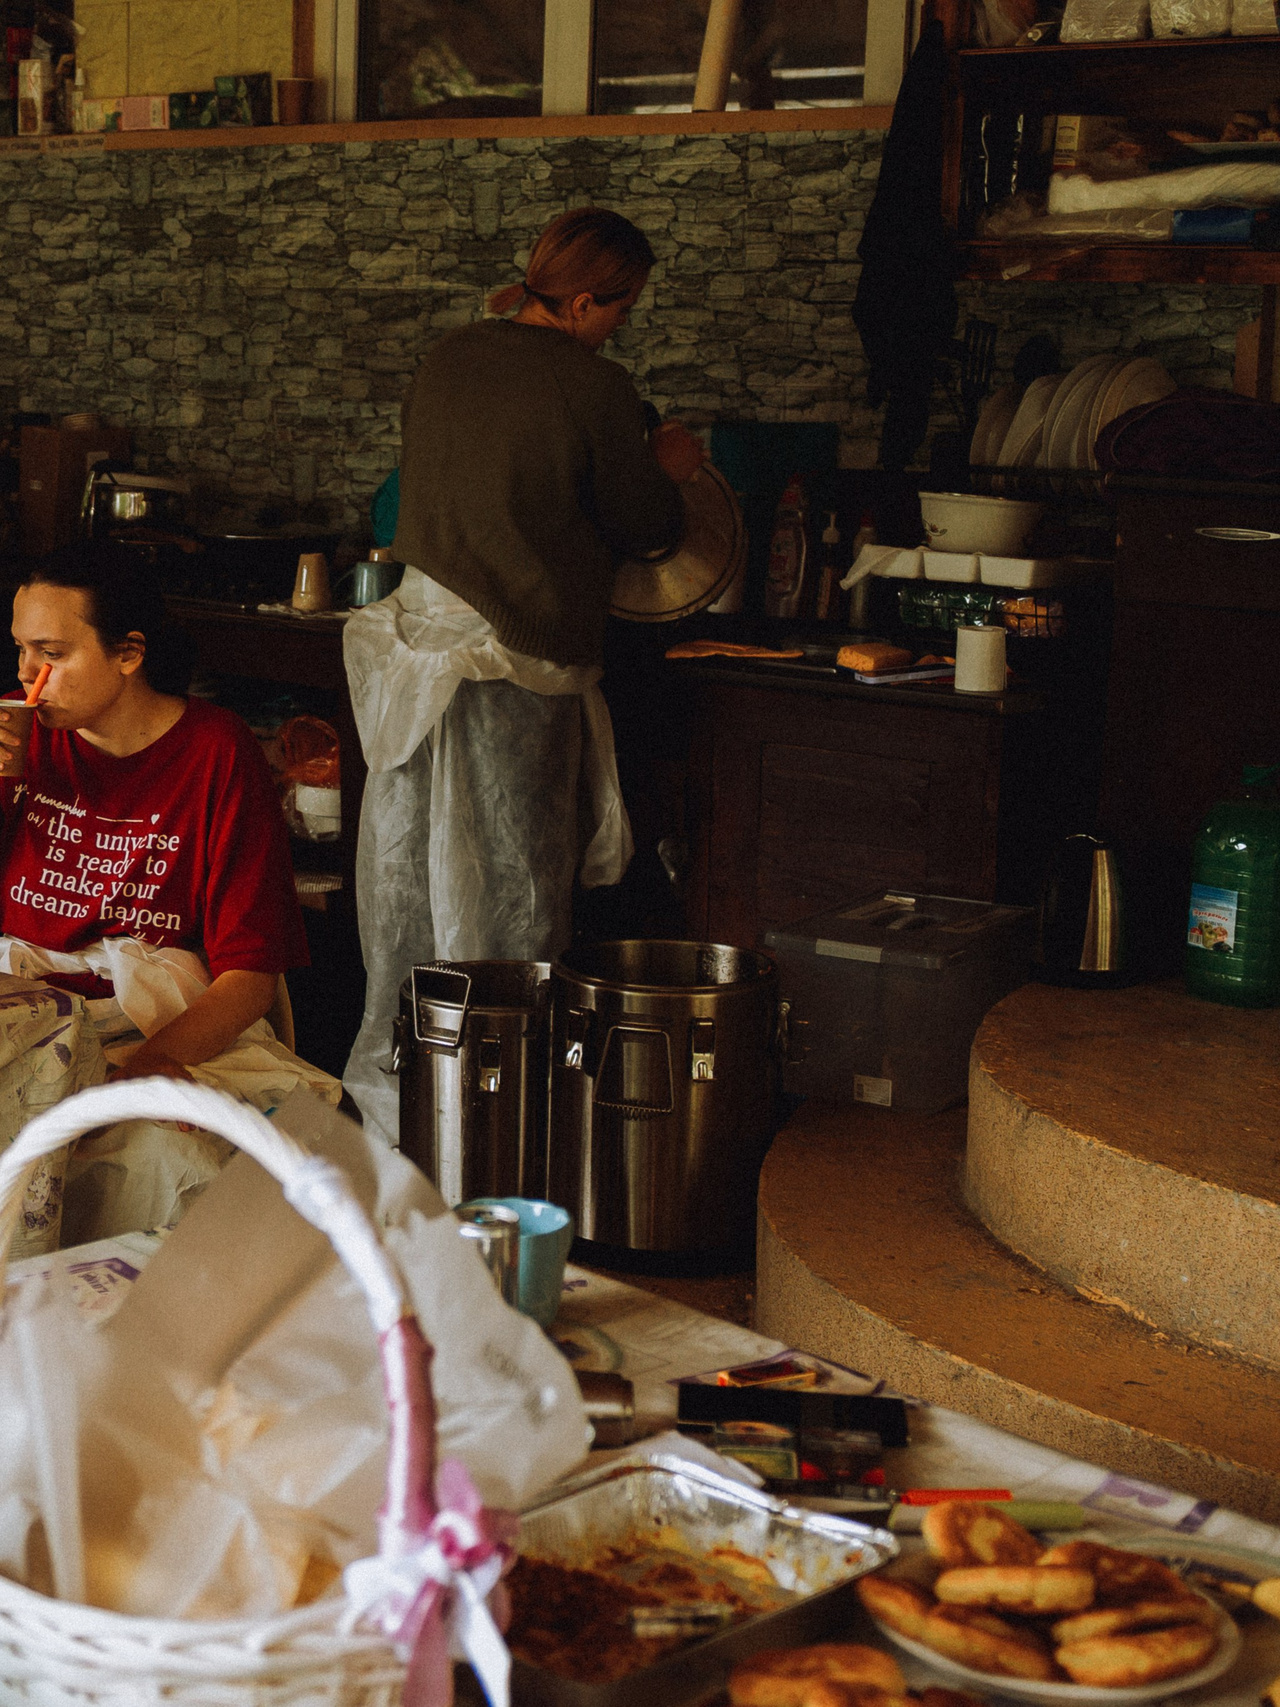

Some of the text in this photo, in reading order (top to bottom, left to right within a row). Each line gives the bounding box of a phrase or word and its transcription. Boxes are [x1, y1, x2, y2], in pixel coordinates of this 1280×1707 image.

[47, 813, 83, 843] the
[95, 829, 180, 852] universe
[45, 839, 167, 878] is ready to
[10, 876, 181, 931] dreams happen
[39, 868, 160, 901] make your
